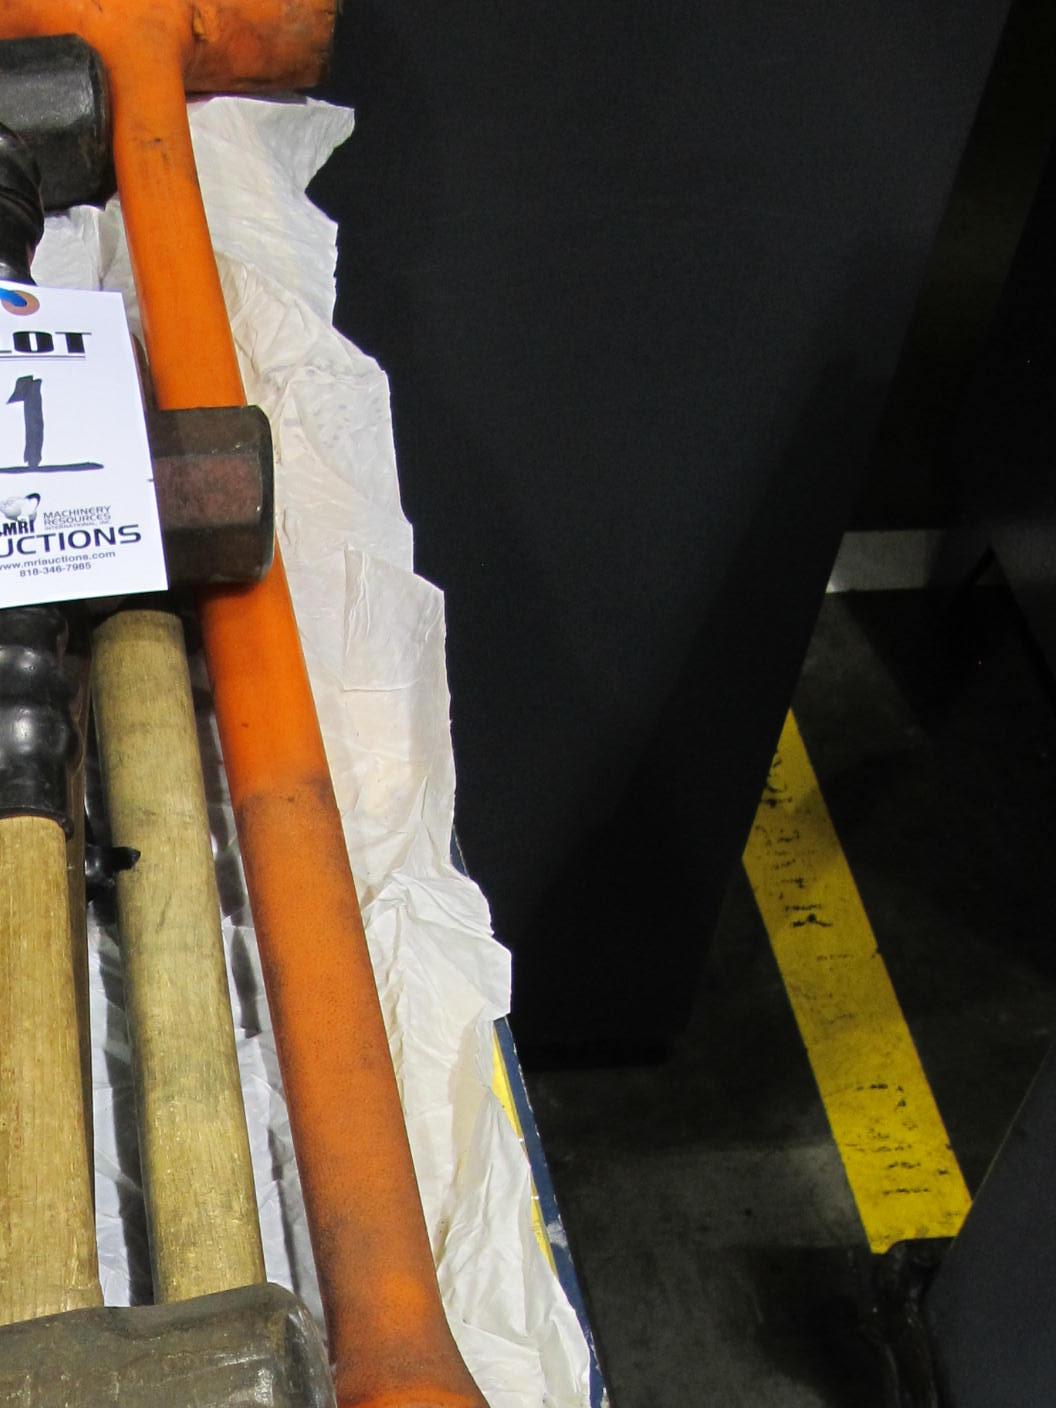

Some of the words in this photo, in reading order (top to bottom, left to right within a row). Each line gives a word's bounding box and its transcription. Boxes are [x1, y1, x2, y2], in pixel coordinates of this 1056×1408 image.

[43, 505, 111, 519] MACHINERY
[44, 514, 111, 526] RESOURCES
[2, 519, 36, 536] MRI
[20, 562, 92, 577] 818-346-7985
